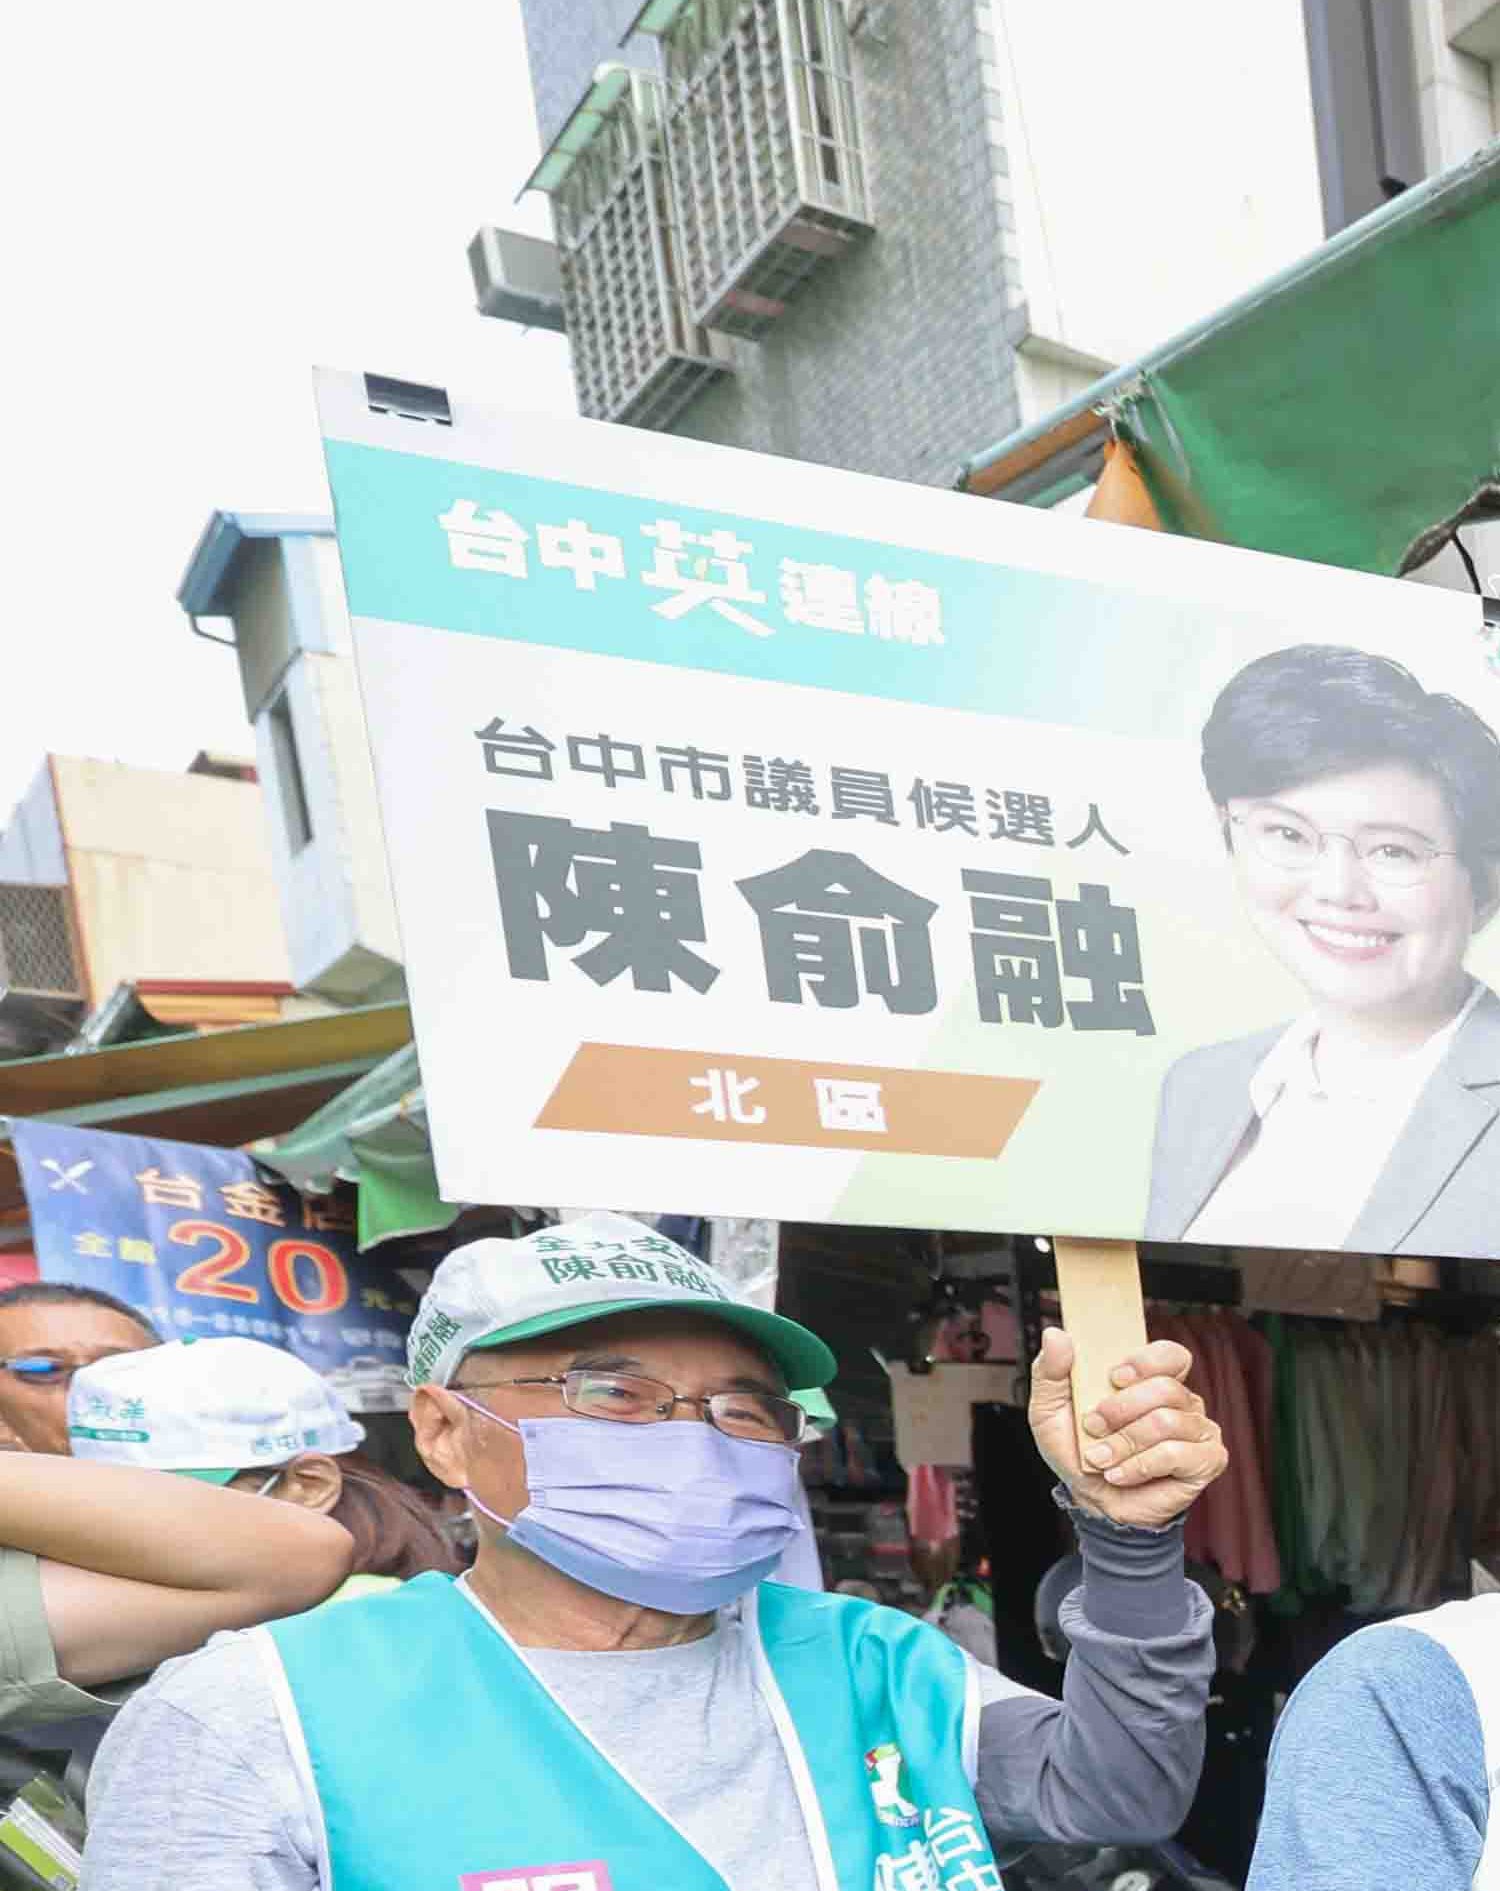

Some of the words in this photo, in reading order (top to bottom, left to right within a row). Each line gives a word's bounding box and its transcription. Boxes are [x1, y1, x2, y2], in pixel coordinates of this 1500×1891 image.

[438, 496, 947, 648] 台中英連線
[473, 717, 1131, 857] 台中市議員候選人
[484, 807, 1157, 1038] 陳俞融
[689, 1068, 888, 1134] 北區
[168, 1219, 348, 1314] 20
